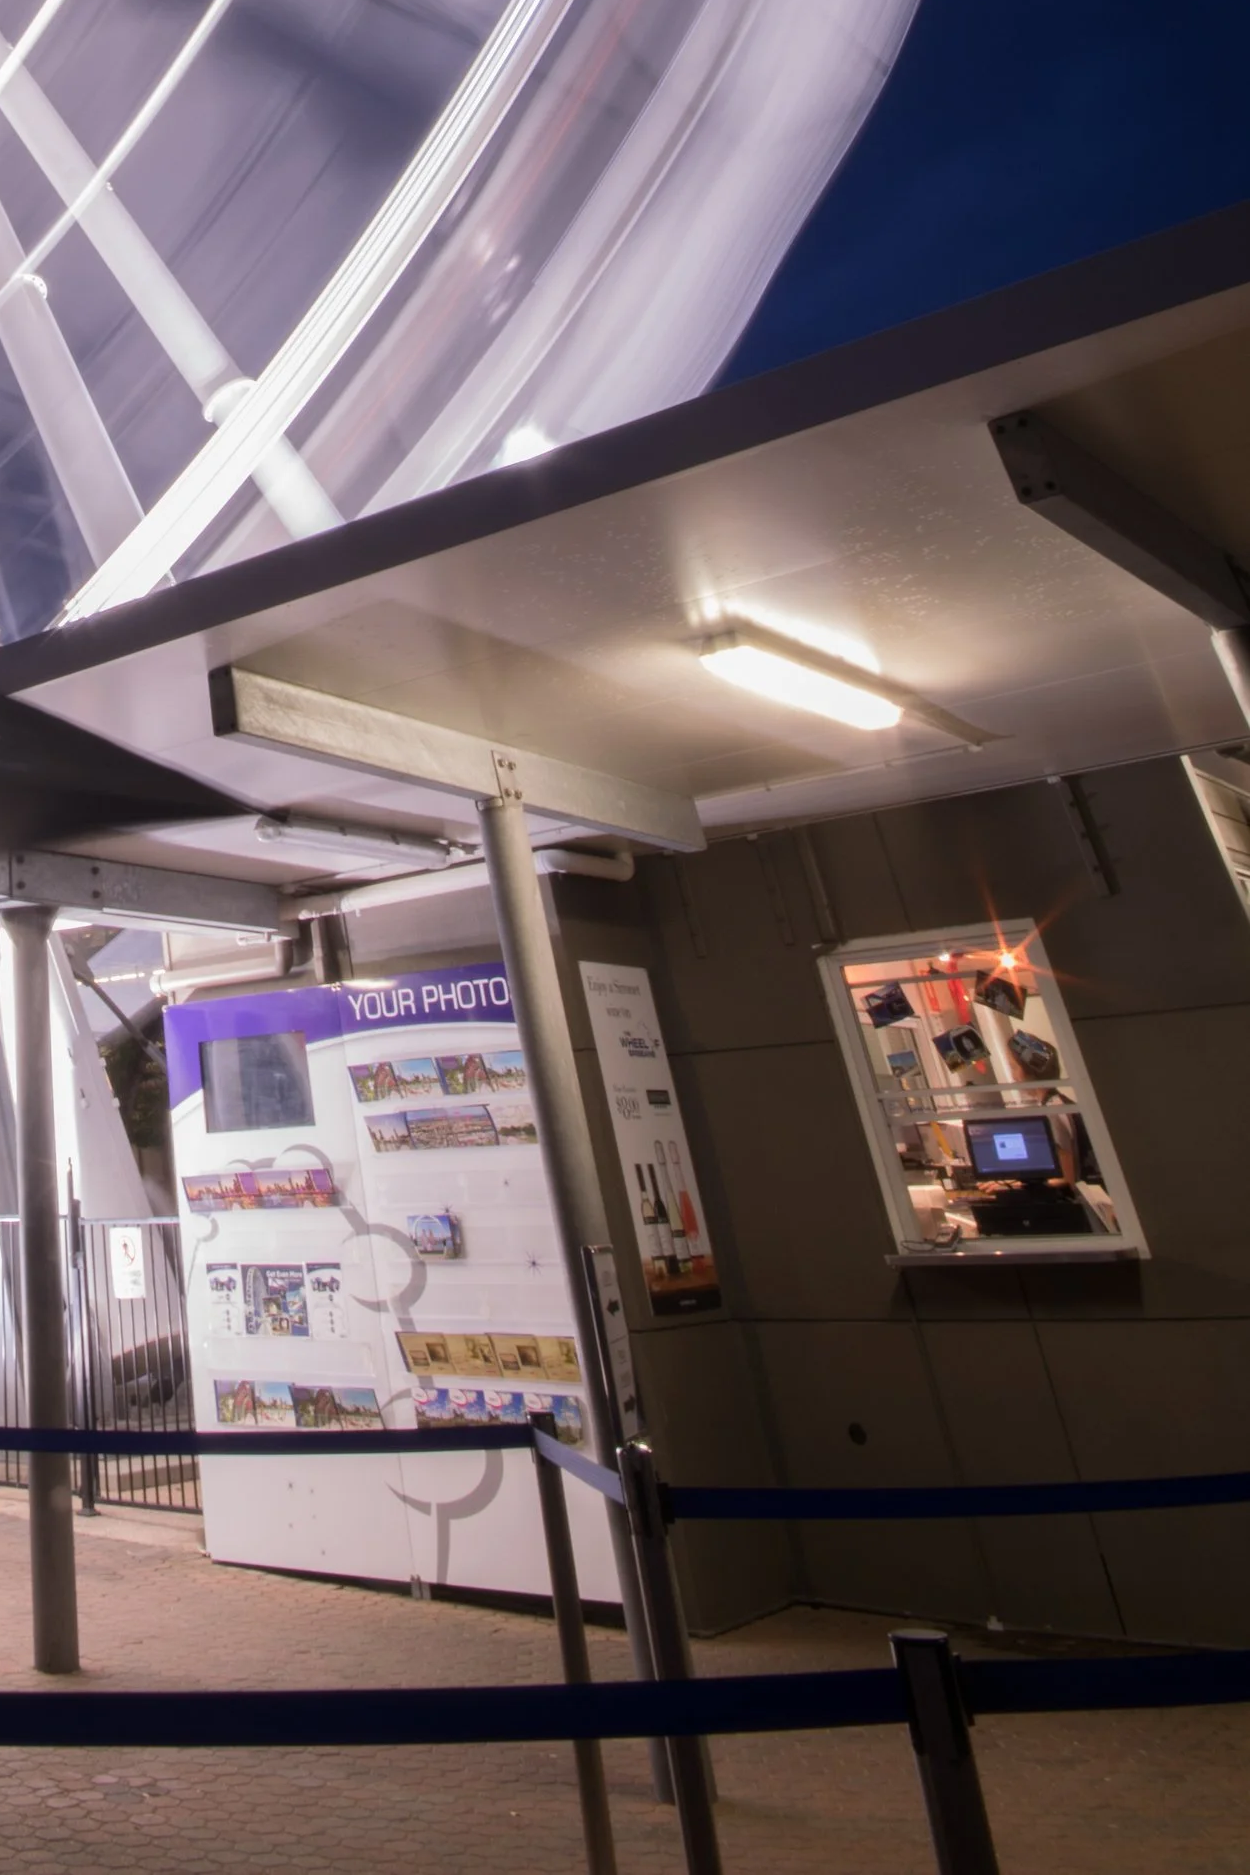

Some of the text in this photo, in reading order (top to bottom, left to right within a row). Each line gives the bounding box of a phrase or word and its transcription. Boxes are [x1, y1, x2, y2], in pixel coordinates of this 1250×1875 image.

[348, 976, 512, 1021] YOUR PHOTO
[619, 1036, 649, 1049] WHEEL
